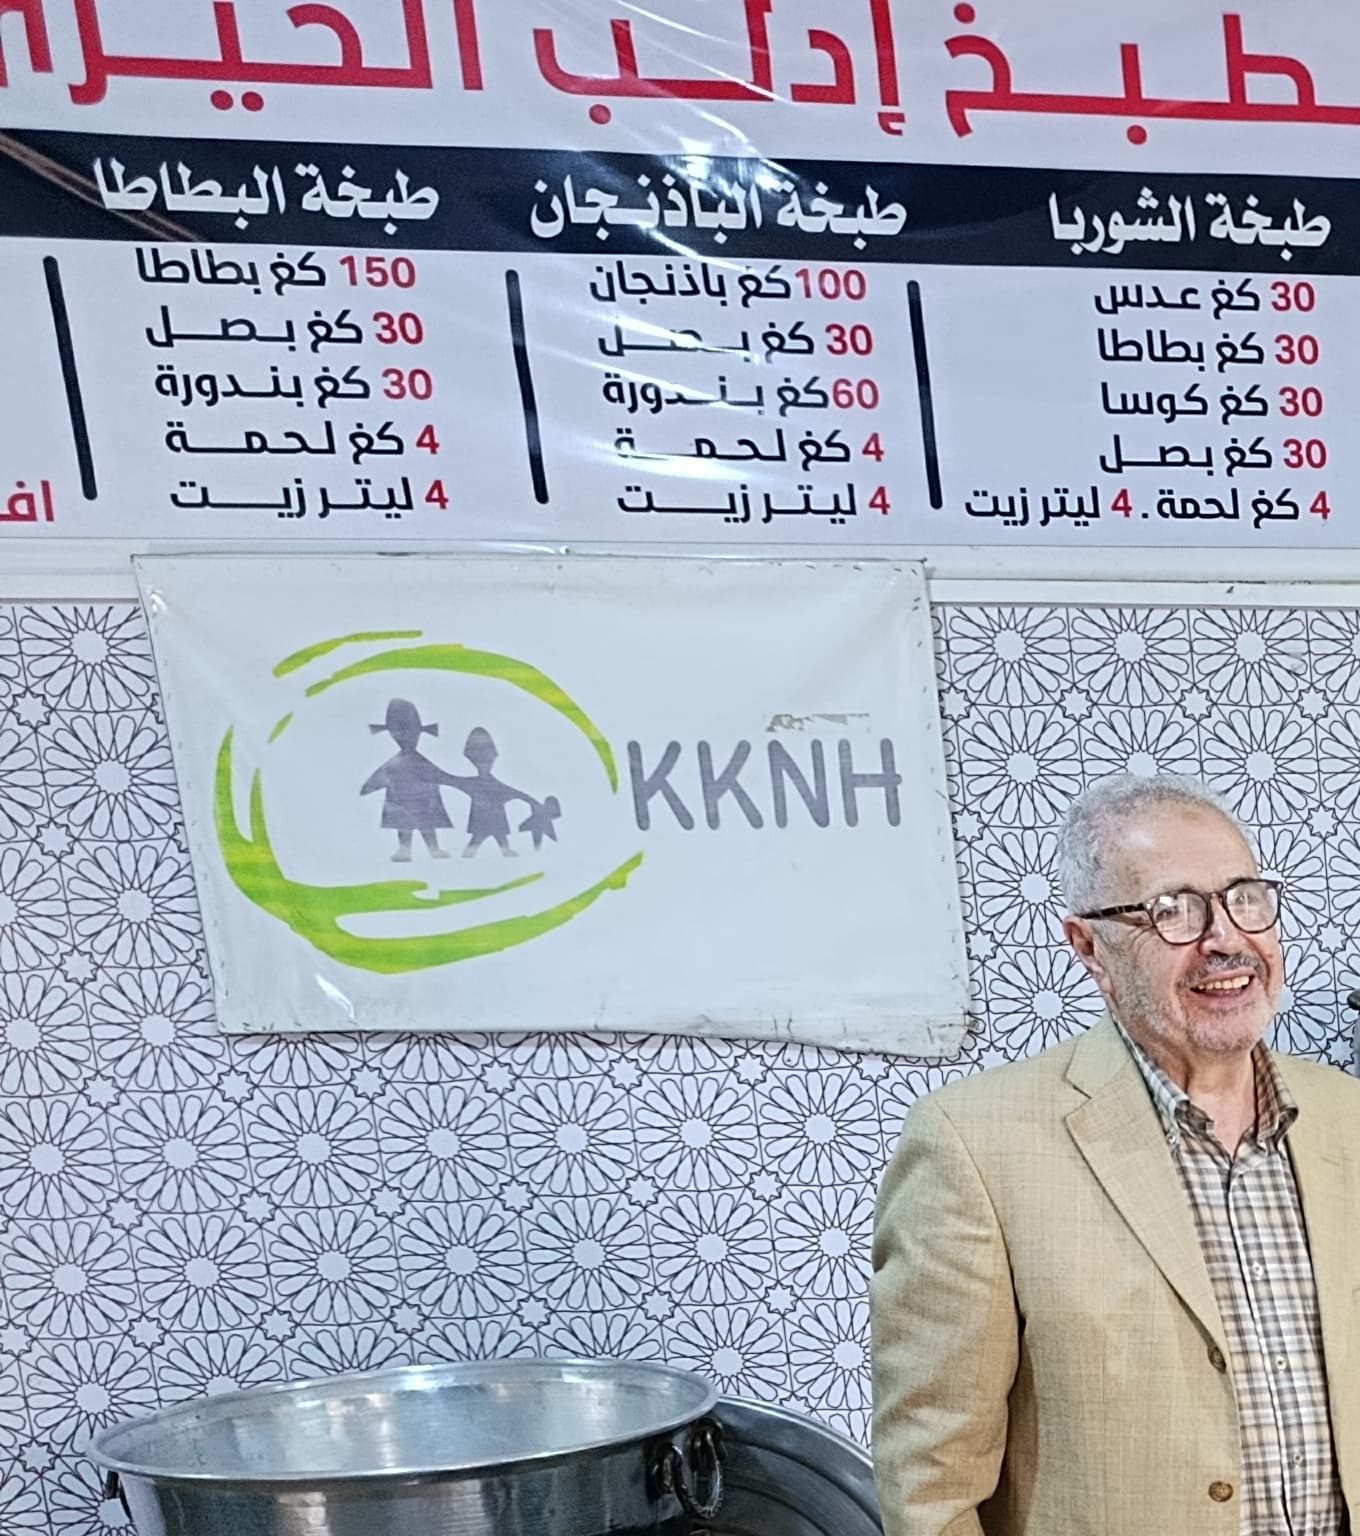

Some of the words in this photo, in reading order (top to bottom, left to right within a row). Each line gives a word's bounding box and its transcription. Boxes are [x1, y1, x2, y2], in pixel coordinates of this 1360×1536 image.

[93, 157, 286, 230] البطاطا
[295, 163, 439, 235] طبخة
[530, 173, 763, 244] الباذنجان
[776, 180, 907, 250] طبخة
[1048, 186, 1197, 256] الشوربا
[1204, 193, 1331, 262] طبخة
[135, 247, 261, 295] بطاطا
[269, 251, 326, 296] كغ
[338, 255, 416, 289] 150
[590, 260, 728, 307] باذنجان
[1094, 283, 1201, 314] عدس
[1211, 278, 1260, 320] كغ
[1270, 280, 1315, 312] 30
[145, 305, 296, 351] بصل
[307, 309, 363, 353] كغ
[372, 311, 424, 345] 30
[762, 321, 814, 364] كغ
[825, 323, 873, 356] 30
[1098, 328, 1206, 372] بطاطا
[1215, 331, 1264, 373] كغ
[1274, 334, 1319, 365] 30
[155, 364, 304, 408] بندورة
[314, 365, 370, 409] كغ
[381, 368, 433, 401] 30
[1101, 381, 1208, 424] كوسا
[1220, 384, 1268, 425] كغ
[1278, 386, 1324, 417] 30
[165, 420, 336, 455] لحمة
[349, 421, 404, 465] كغ
[415, 424, 440, 455] 4
[799, 429, 851, 471] كغ
[861, 432, 884, 462] 4
[1099, 434, 1214, 476] بصل
[1224, 436, 1272, 477] كغ
[1282, 438, 1327, 469] 30
[425, 479, 449, 510] 4
[868, 486, 891, 515] 4
[1111, 488, 1133, 518] 4
[1251, 487, 1299, 529] كغ
[1309, 491, 1331, 519] 4
[626, 738, 902, 831] KKNH
